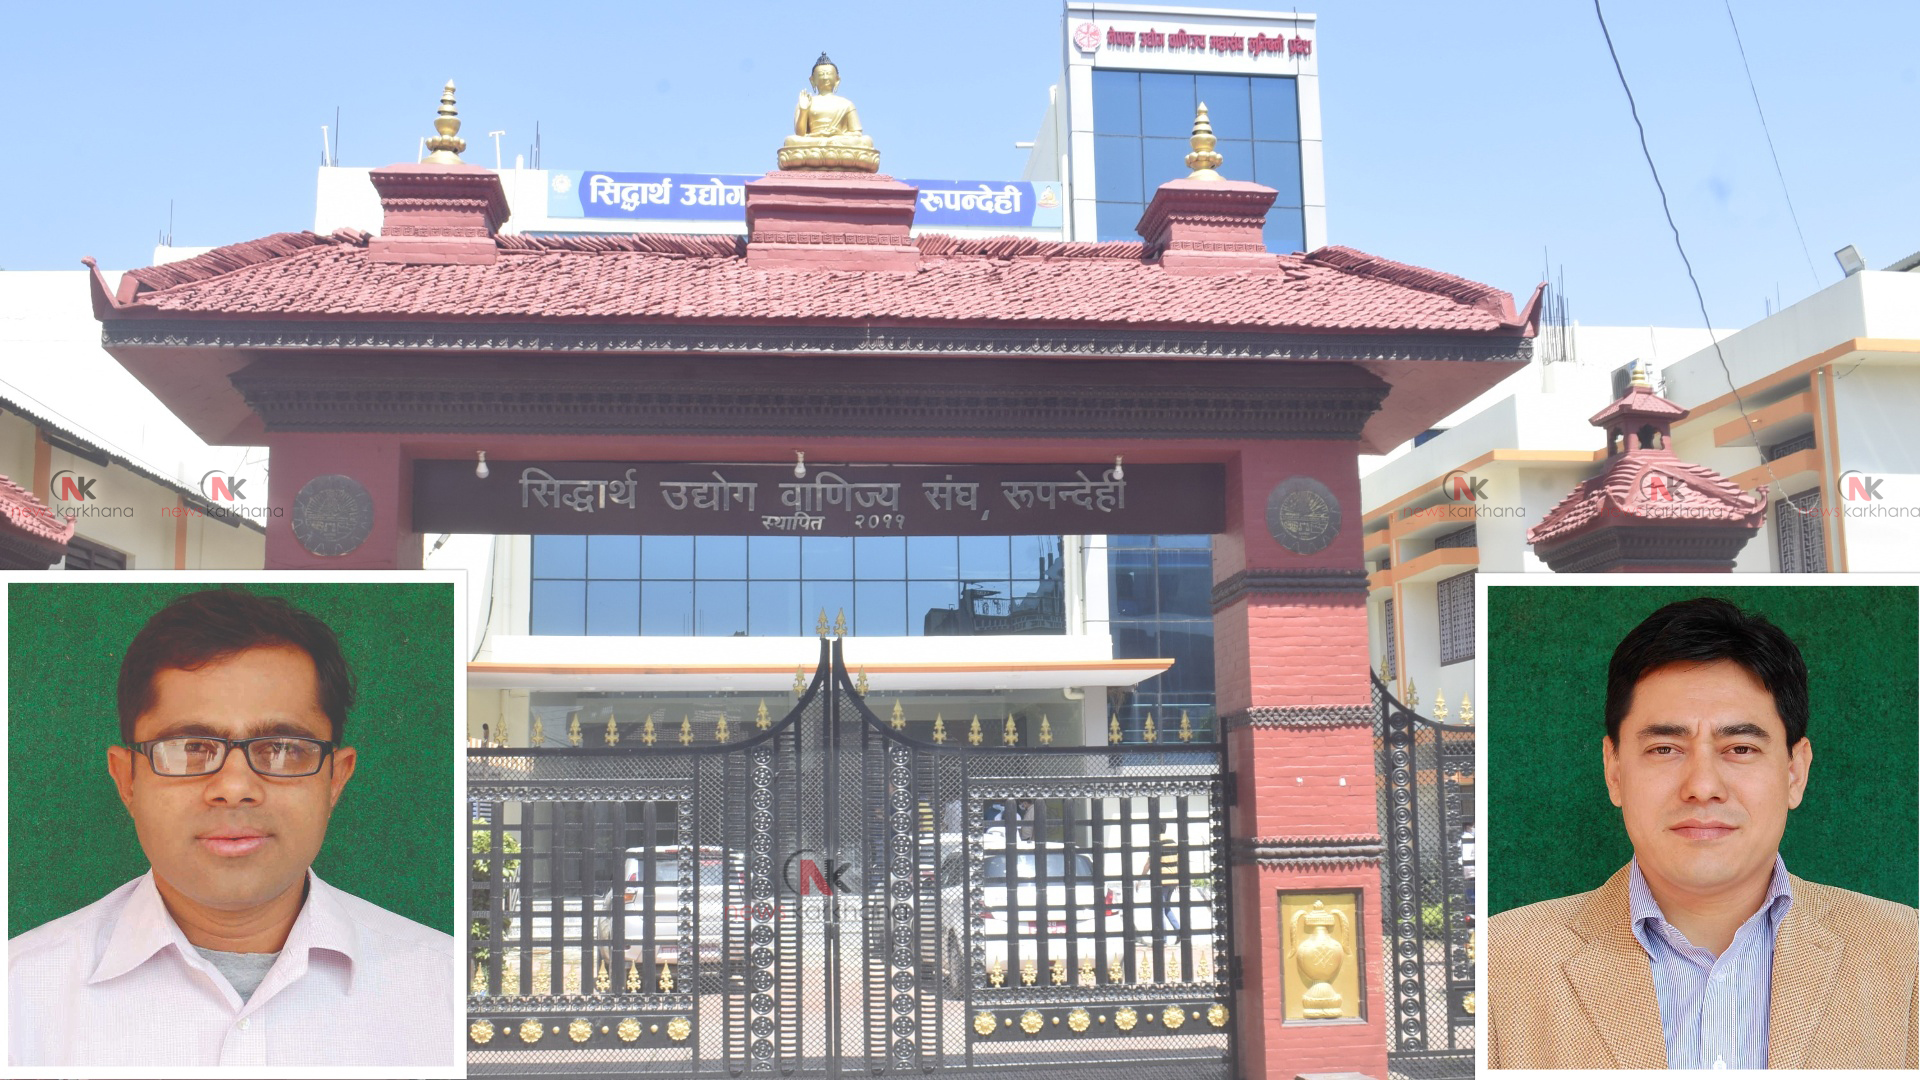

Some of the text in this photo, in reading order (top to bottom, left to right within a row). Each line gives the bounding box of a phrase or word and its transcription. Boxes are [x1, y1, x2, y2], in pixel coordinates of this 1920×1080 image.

[1106, 26, 1136, 48] नेपाल
[1139, 28, 1165, 48] उद्योग
[590, 174, 1022, 214] सिद्धार्थ उद्योग रूपन्देही
[518, 467, 1127, 521] सिद्धार्थ उद्योग वाणिज्य संघ, रूपन्देही
[761, 511, 906, 531] स्थापित २०११
